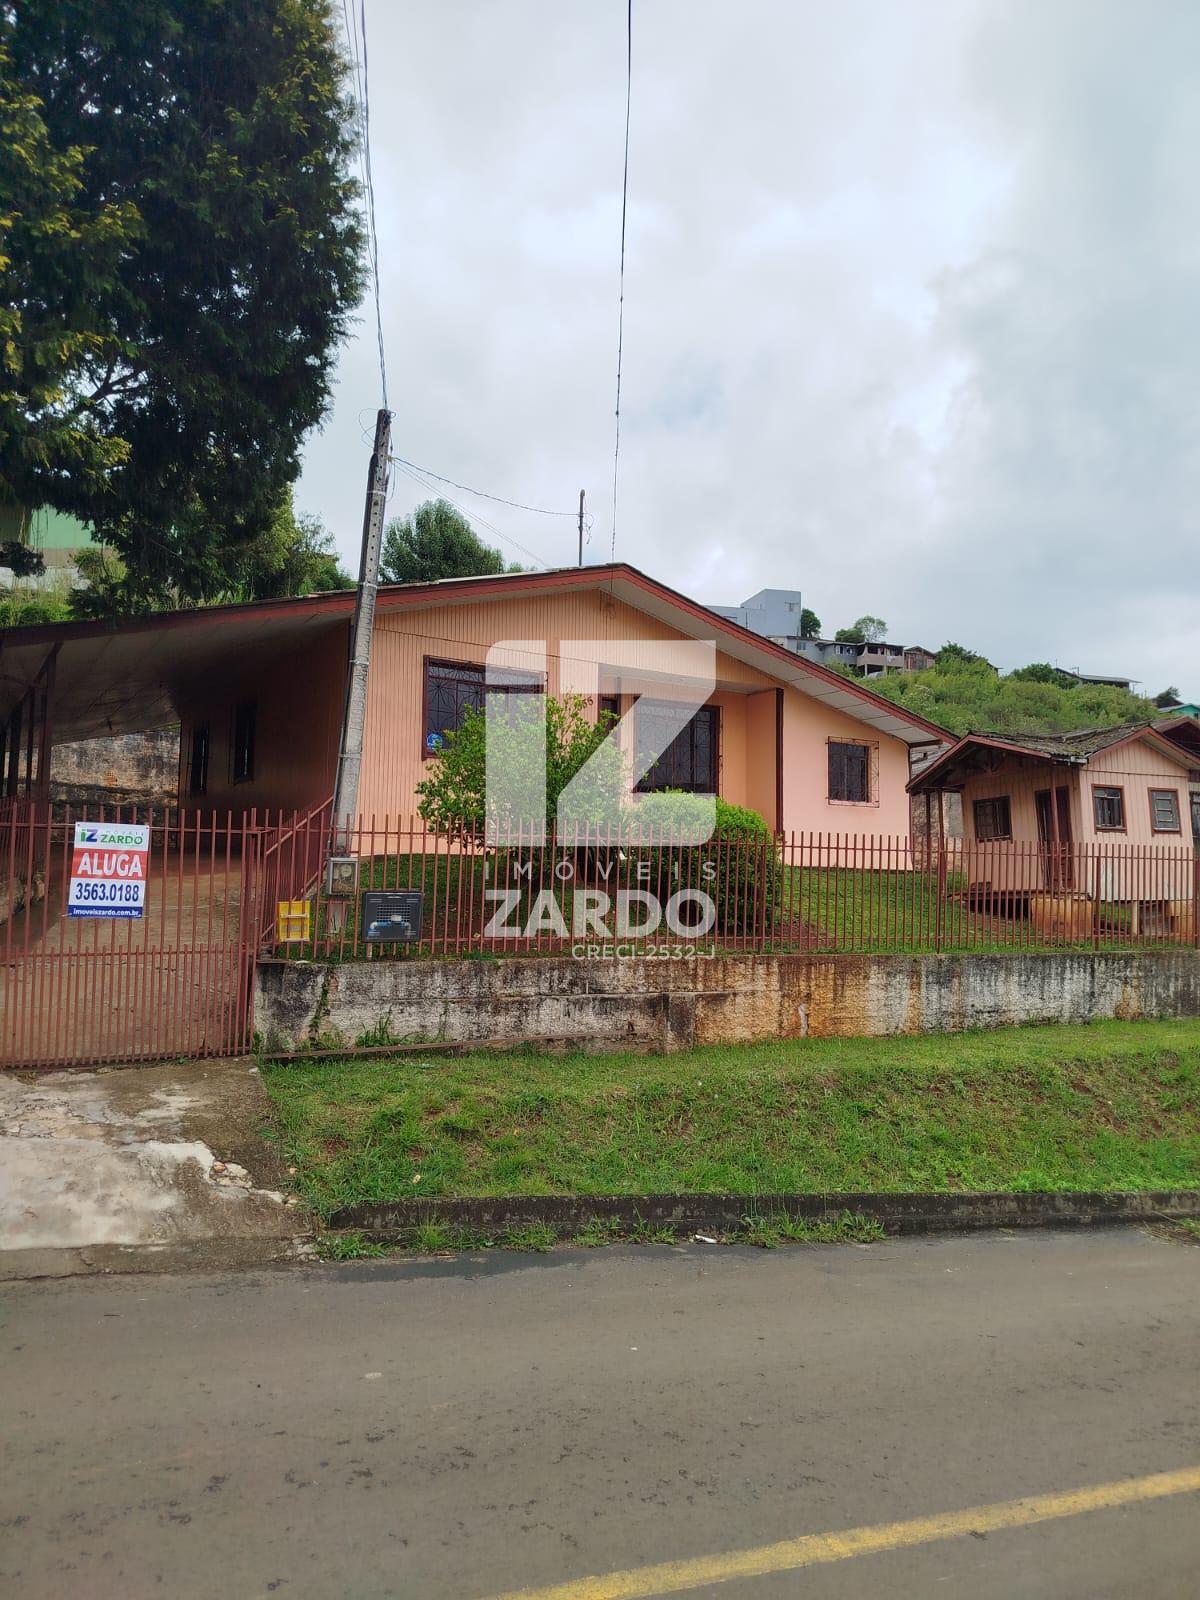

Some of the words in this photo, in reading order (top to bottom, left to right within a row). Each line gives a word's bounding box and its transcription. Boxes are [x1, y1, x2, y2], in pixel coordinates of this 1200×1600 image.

[100, 834, 144, 845] ZARDO
[77, 852, 143, 877] ALUGA
[75, 882, 140, 902] 3563.0188
